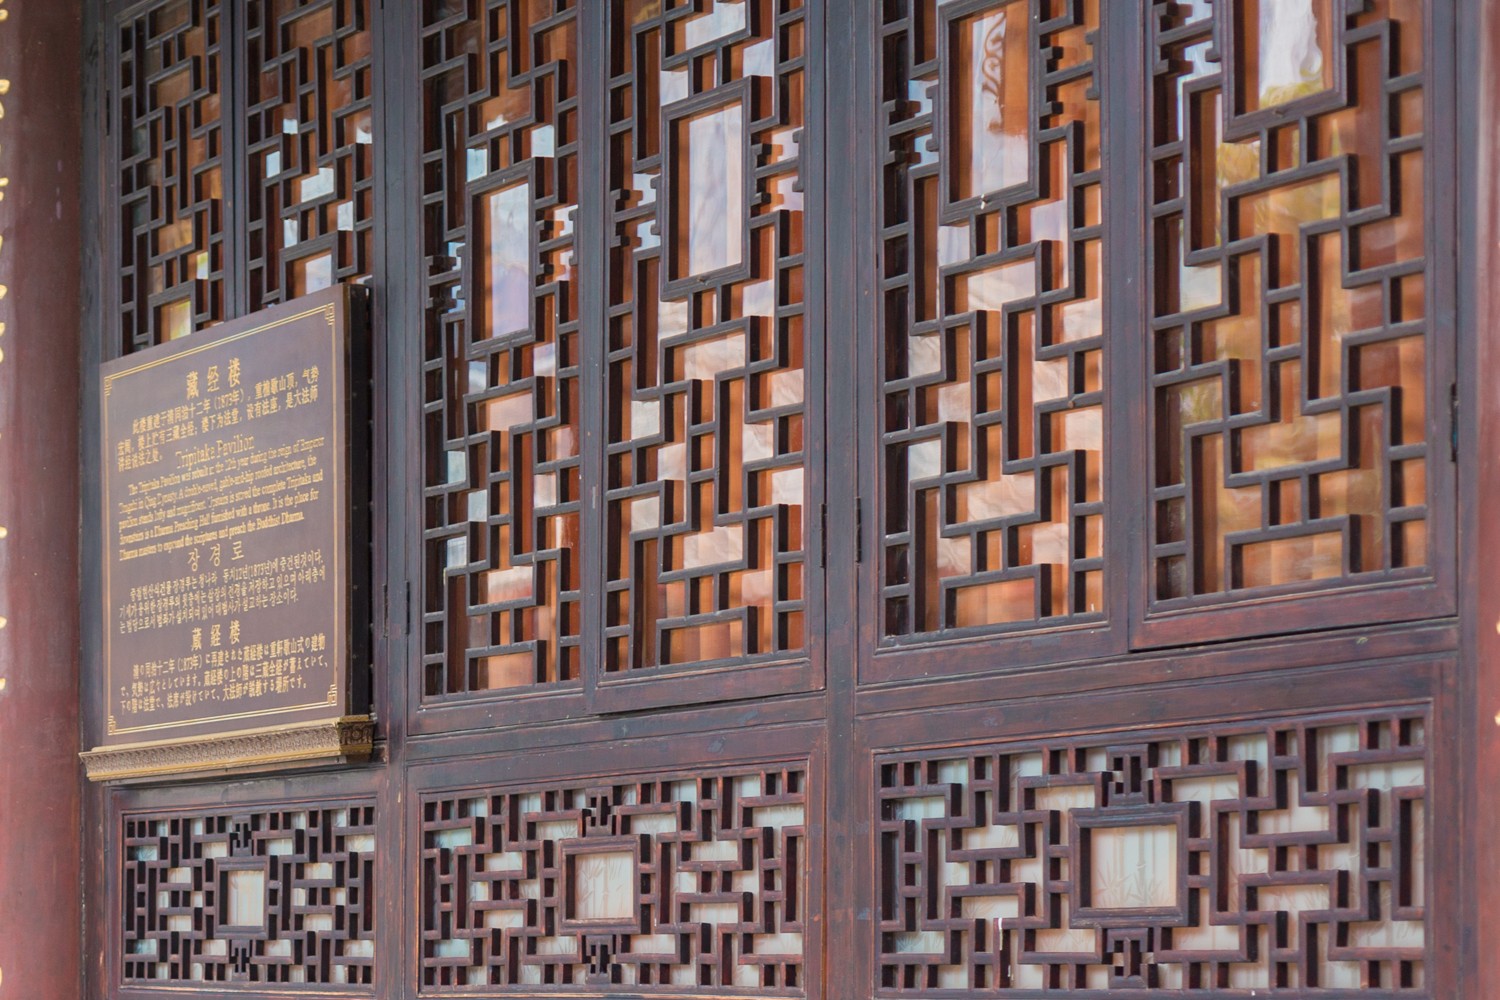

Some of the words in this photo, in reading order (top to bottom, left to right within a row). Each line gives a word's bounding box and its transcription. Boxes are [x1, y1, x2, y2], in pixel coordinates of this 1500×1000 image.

[186, 357, 240, 399] 藏经楼
[128, 483, 137, 495] The
[138, 478, 159, 494] Tripitaka
[160, 473, 180, 487] Pavilion
[181, 472, 190, 480] was
[191, 465, 207, 479] rebuilt
[215, 461, 223, 472] the
[225, 457, 236, 470] 12th
[237, 457, 248, 470] year
[250, 450, 266, 463] during
[268, 447, 276, 458] the
[277, 444, 291, 458] reign
[293, 439, 299, 452] of
[300, 437, 324, 452] Emperor
[175, 443, 214, 470] Tripitaka
[216, 434, 254, 457] Pavilion
[118, 516, 137, 532] pavilion
[138, 511, 153, 524] stands
[154, 508, 165, 521] lofty
[166, 505, 175, 517] and
[176, 500, 206, 516] magnificent.
[229, 491, 234, 502] is
[235, 487, 251, 501] stored
[252, 485, 260, 496] the
[261, 480, 285, 495] complete
[286, 473, 311, 490] Tripitaka
[312, 469, 322, 482] and
[144, 530, 149, 539] is
[153, 525, 173, 537] Dharma
[173, 517, 198, 532] Preaching
[199, 513, 209, 526] Hall
[210, 507, 234, 523] furnished
[235, 505, 247, 516] with
[248, 506, 251, 514] a
[252, 502, 270, 513] throne.
[272, 498, 277, 509] It
[278, 496, 283, 507] is
[284, 495, 293, 506] the
[294, 492, 308, 507] place
[309, 488, 318, 500] for
[119, 549, 137, 560] Dharma
[138, 545, 156, 556] masters
[157, 543, 162, 551] to
[163, 535, 184, 552] expound
[184, 534, 192, 546] the
[193, 531, 217, 545] scriptures
[218, 525, 227, 538] and
[228, 522, 245, 539] preach
[247, 520, 255, 531] the
[256, 514, 280, 529] Buddhist
[281, 511, 304, 524] Dharma.
